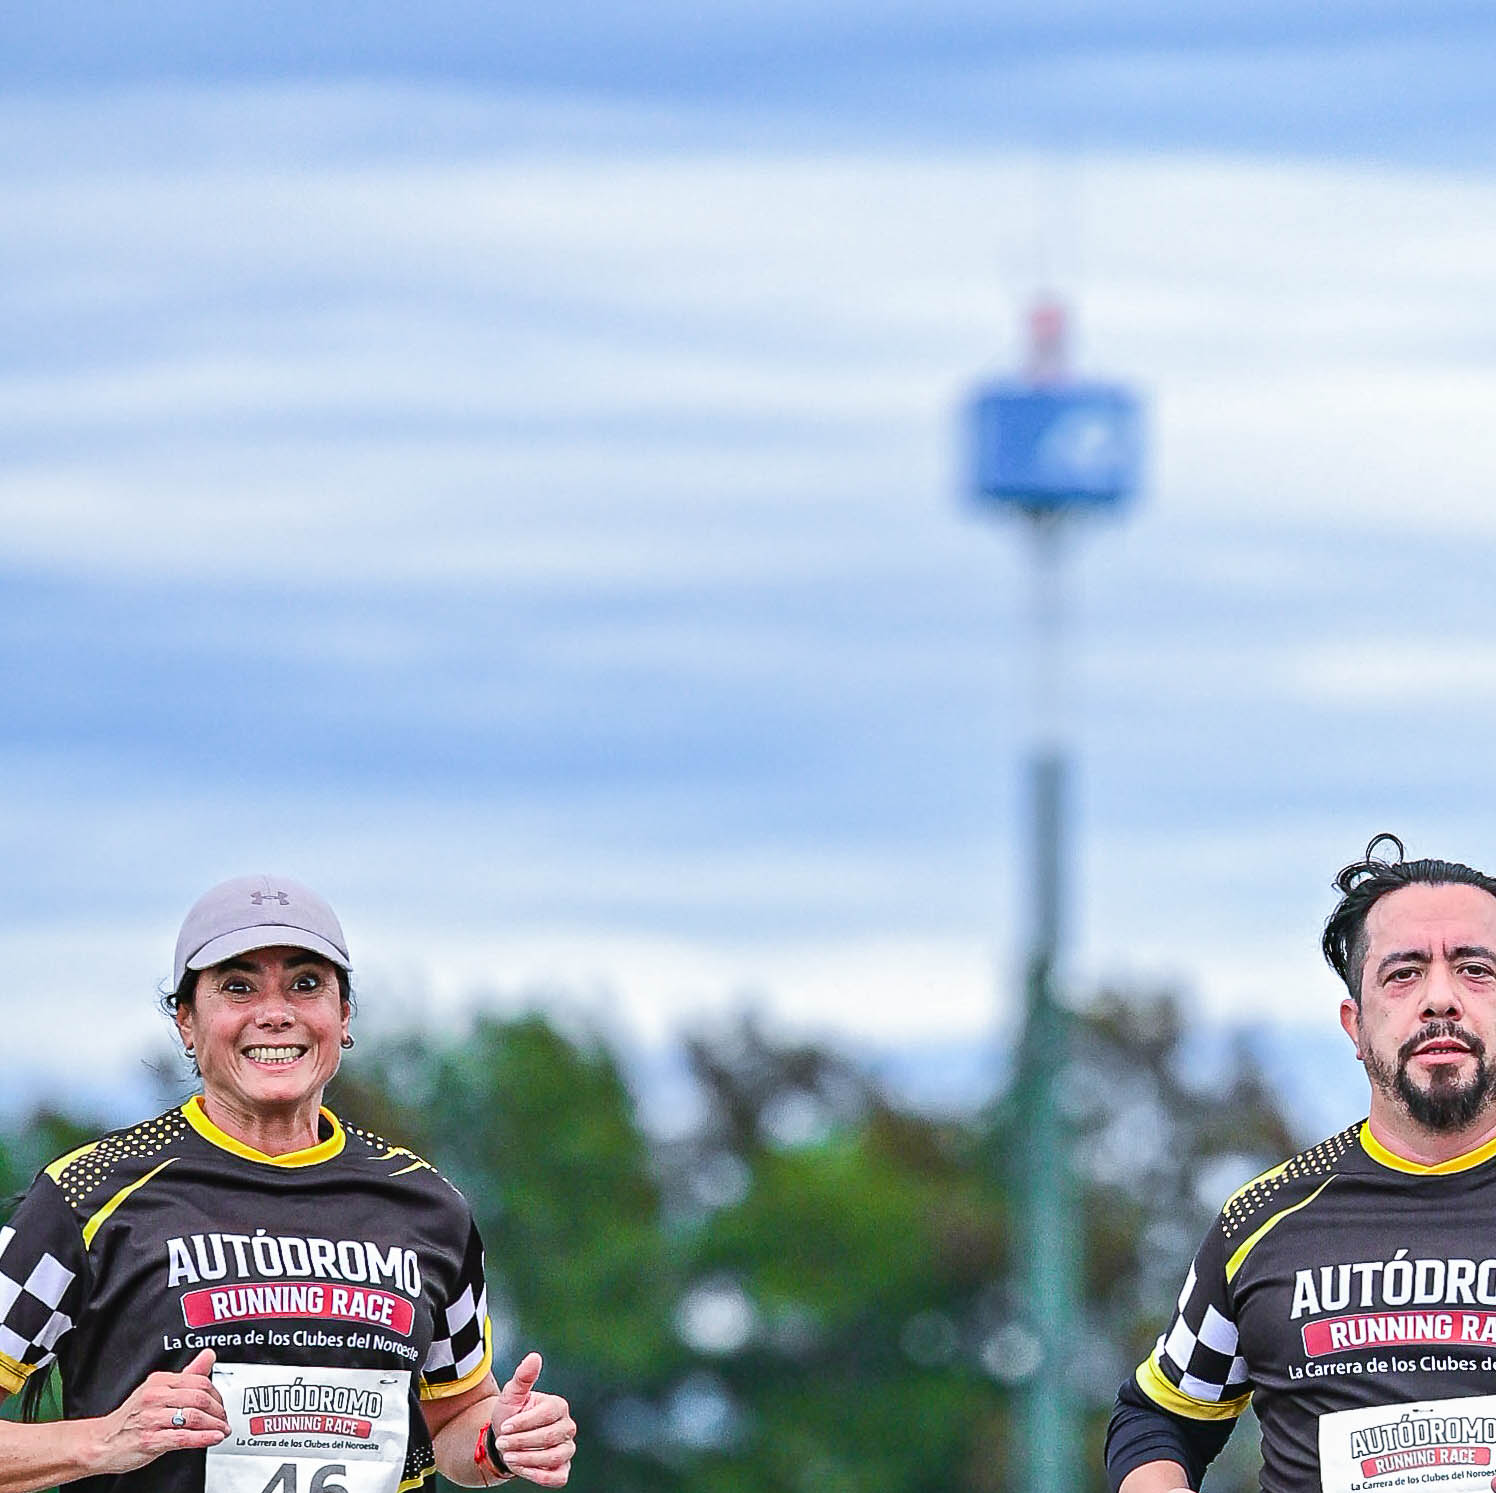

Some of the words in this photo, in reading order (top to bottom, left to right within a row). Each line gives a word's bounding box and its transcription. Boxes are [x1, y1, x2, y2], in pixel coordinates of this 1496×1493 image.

[166, 1228, 422, 1298] AUTÓDROMO
[210, 1286, 324, 1321] RUNNING
[331, 1288, 395, 1326] RACE
[163, 1335, 182, 1351] La
[185, 1332, 241, 1349] Carrera
[244, 1330, 264, 1345] de
[268, 1330, 290, 1346] los
[293, 1330, 343, 1347] Clubes
[347, 1333, 370, 1349] del
[373, 1335, 419, 1361] Noroeste
[1329, 1314, 1453, 1350] RUNNING
[1288, 1364, 1304, 1380] La
[1305, 1361, 1362, 1378] Carrera
[1366, 1357, 1388, 1374] de
[1391, 1356, 1416, 1374] los
[1420, 1355, 1477, 1372] Clubes
[242, 1377, 383, 1418] AUTÓDROMO
[263, 1416, 321, 1433] RUNNING
[325, 1418, 358, 1435] RACE
[236, 1438, 245, 1446] La
[247, 1438, 277, 1447] Carrera
[278, 1439, 289, 1447] de
[290, 1439, 302, 1448] los
[304, 1440, 330, 1449] Clubes
[331, 1441, 344, 1449] del
[345, 1441, 379, 1450] Noroeste
[1375, 1449, 1435, 1474] RUNNING
[1440, 1449, 1476, 1464] RACE
[1351, 1482, 1361, 1491] La
[1362, 1480, 1392, 1490] Carrera
[1395, 1477, 1405, 1486] de
[1407, 1476, 1419, 1484] los
[1422, 1474, 1449, 1483] Clubes
[1451, 1471, 1465, 1479] del
